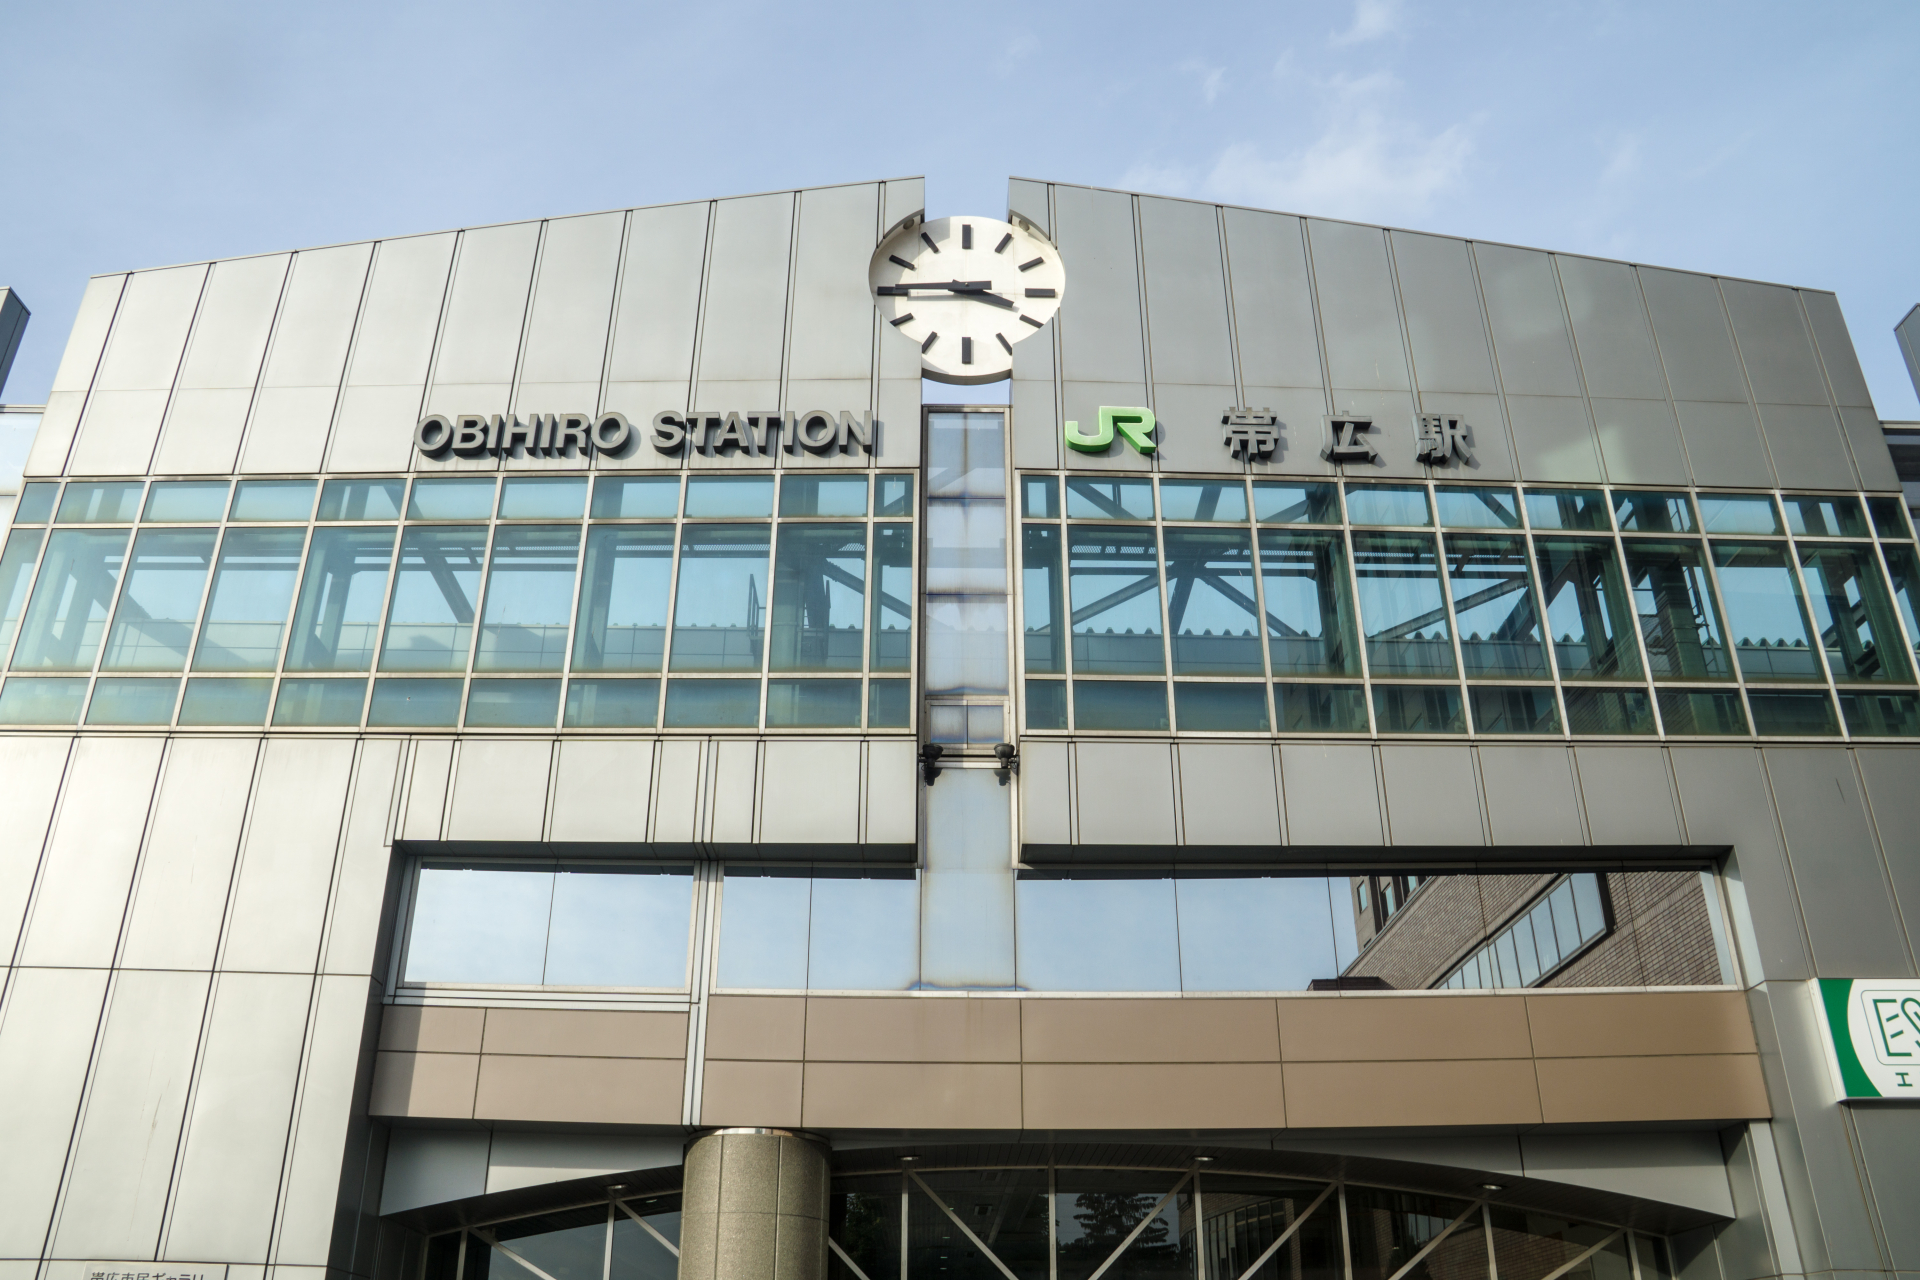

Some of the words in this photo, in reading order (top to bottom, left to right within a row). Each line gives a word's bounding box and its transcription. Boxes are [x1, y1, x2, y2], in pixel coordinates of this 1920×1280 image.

[413, 411, 631, 458] OBIHIRO
[650, 410, 874, 455] STATION
[1065, 406, 1156, 454] JR
[1221, 406, 1471, 465] 帯広駅
